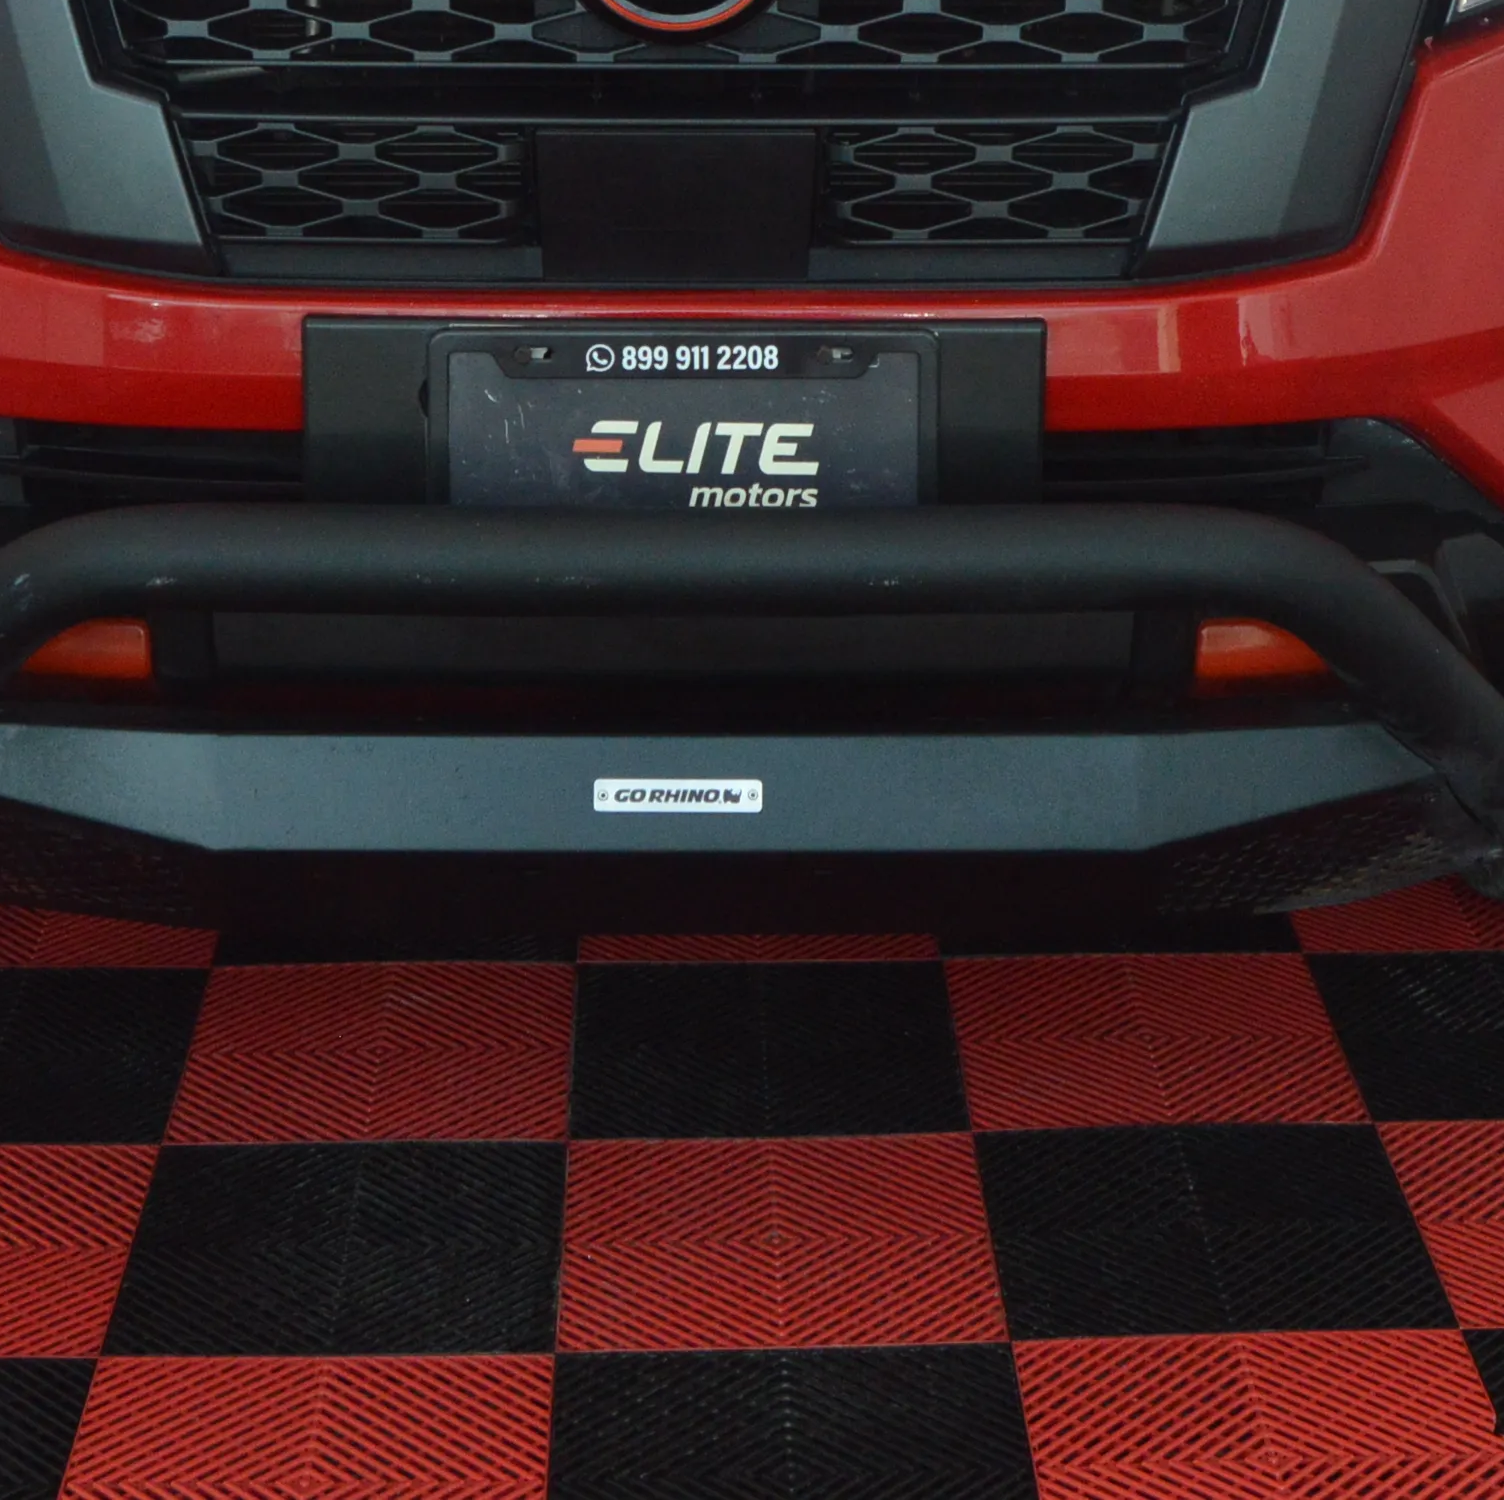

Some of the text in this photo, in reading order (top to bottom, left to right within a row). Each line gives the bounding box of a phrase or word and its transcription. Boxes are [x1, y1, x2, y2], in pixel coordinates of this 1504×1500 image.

[621, 344, 779, 371] 899 911 2208
[571, 419, 820, 476] ELITE
[688, 482, 819, 508] motors
[613, 787, 721, 804] GO RHINO
